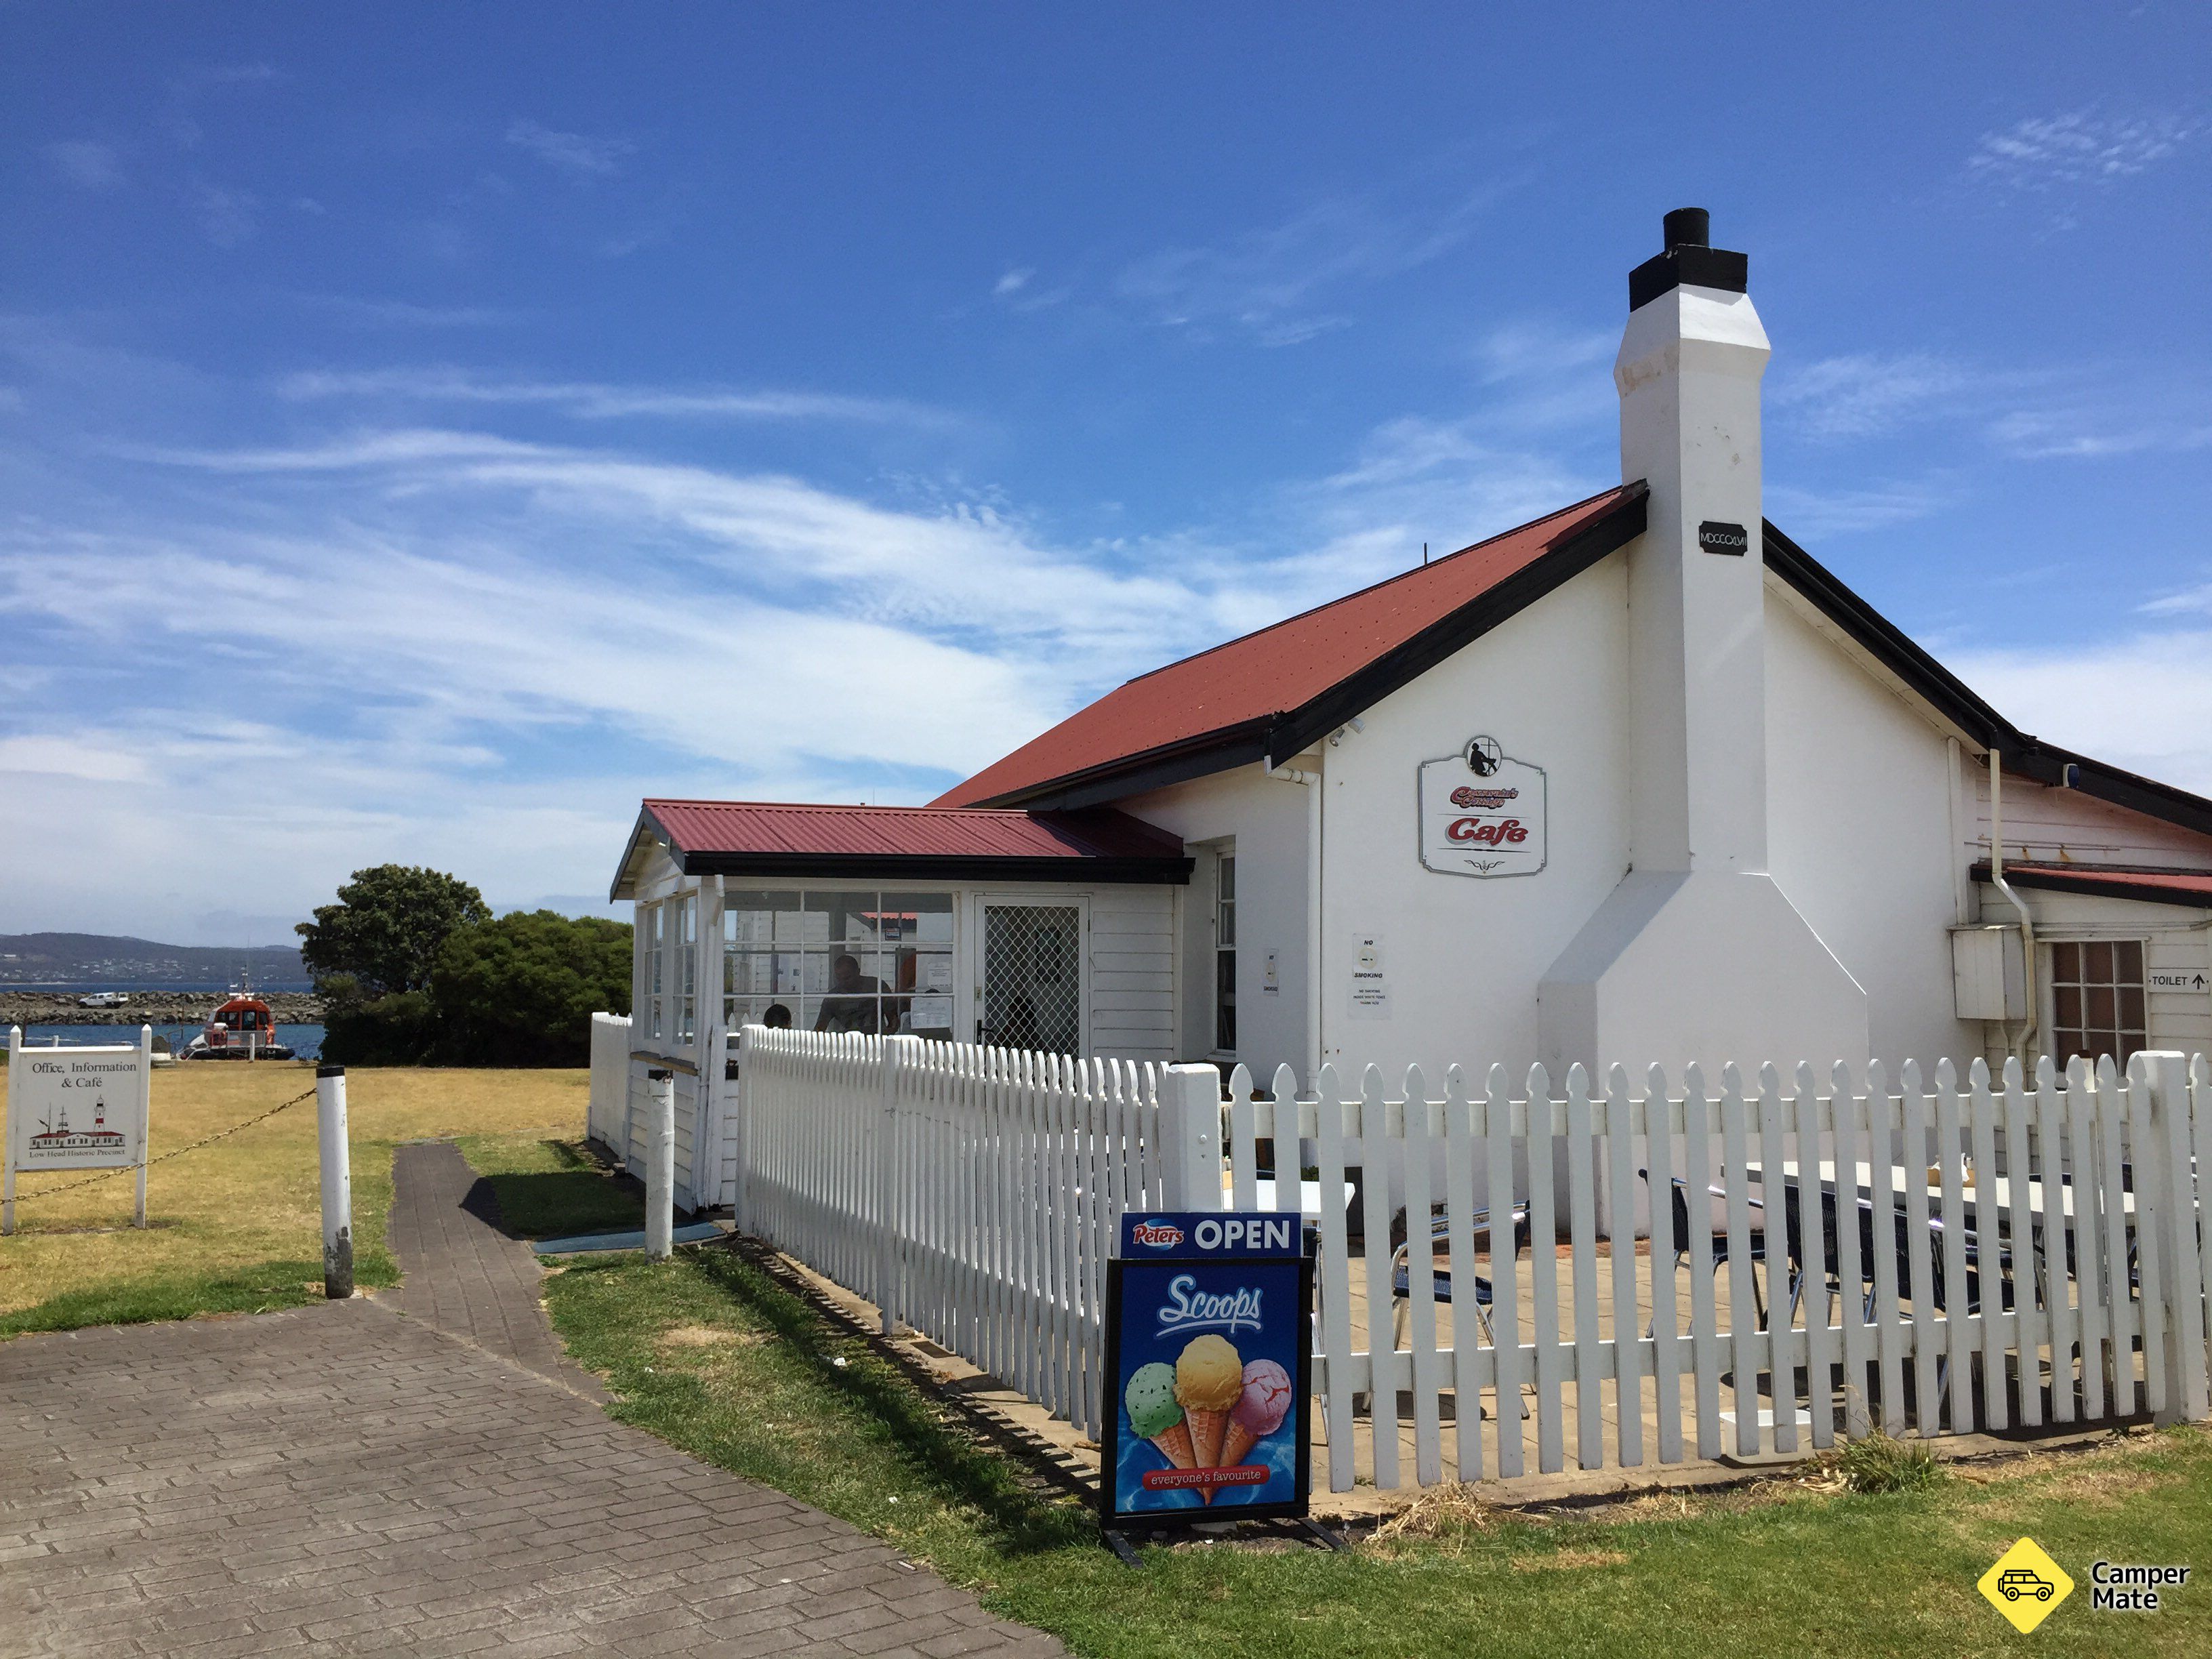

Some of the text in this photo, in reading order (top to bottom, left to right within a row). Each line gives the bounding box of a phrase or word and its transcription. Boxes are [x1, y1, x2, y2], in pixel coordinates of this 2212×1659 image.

[1446, 817, 1528, 846] Cafe
[2152, 976, 2188, 985] TOILET
[32, 1061, 137, 1074] Office, Information
[61, 1077, 102, 1088] & Café
[1133, 1220, 1290, 1249] Peters OPEN
[1159, 1275, 1261, 1334] Scoops
[1151, 1470, 1261, 1486] everyone's favourite
